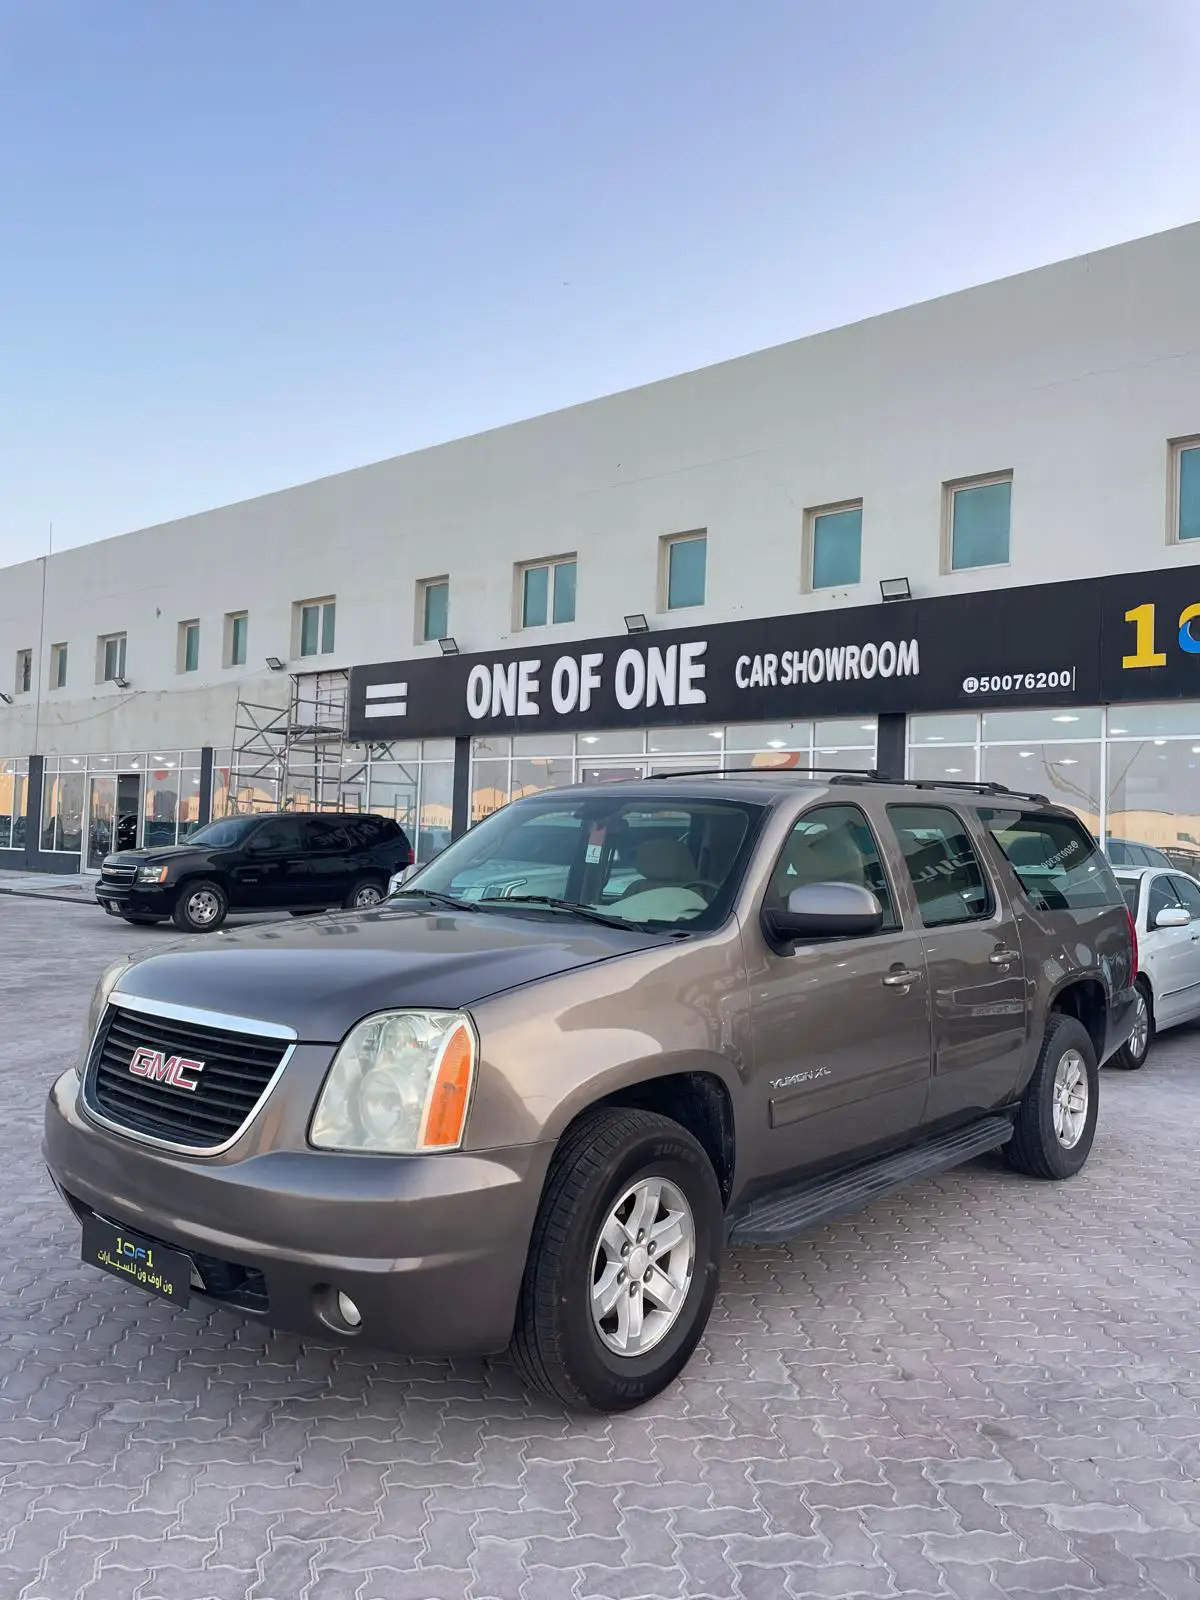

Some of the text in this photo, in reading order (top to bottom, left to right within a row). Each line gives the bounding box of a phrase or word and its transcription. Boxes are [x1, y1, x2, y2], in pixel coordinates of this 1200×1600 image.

[466, 641, 708, 719] ONE OF ONE
[735, 638, 920, 689] CAR SHOWROOM
[979, 670, 1071, 692] 50076200
[129, 1046, 205, 1091] GMC
[137, 1268, 147, 1283] ون
[162, 1280, 173, 1294] ون
